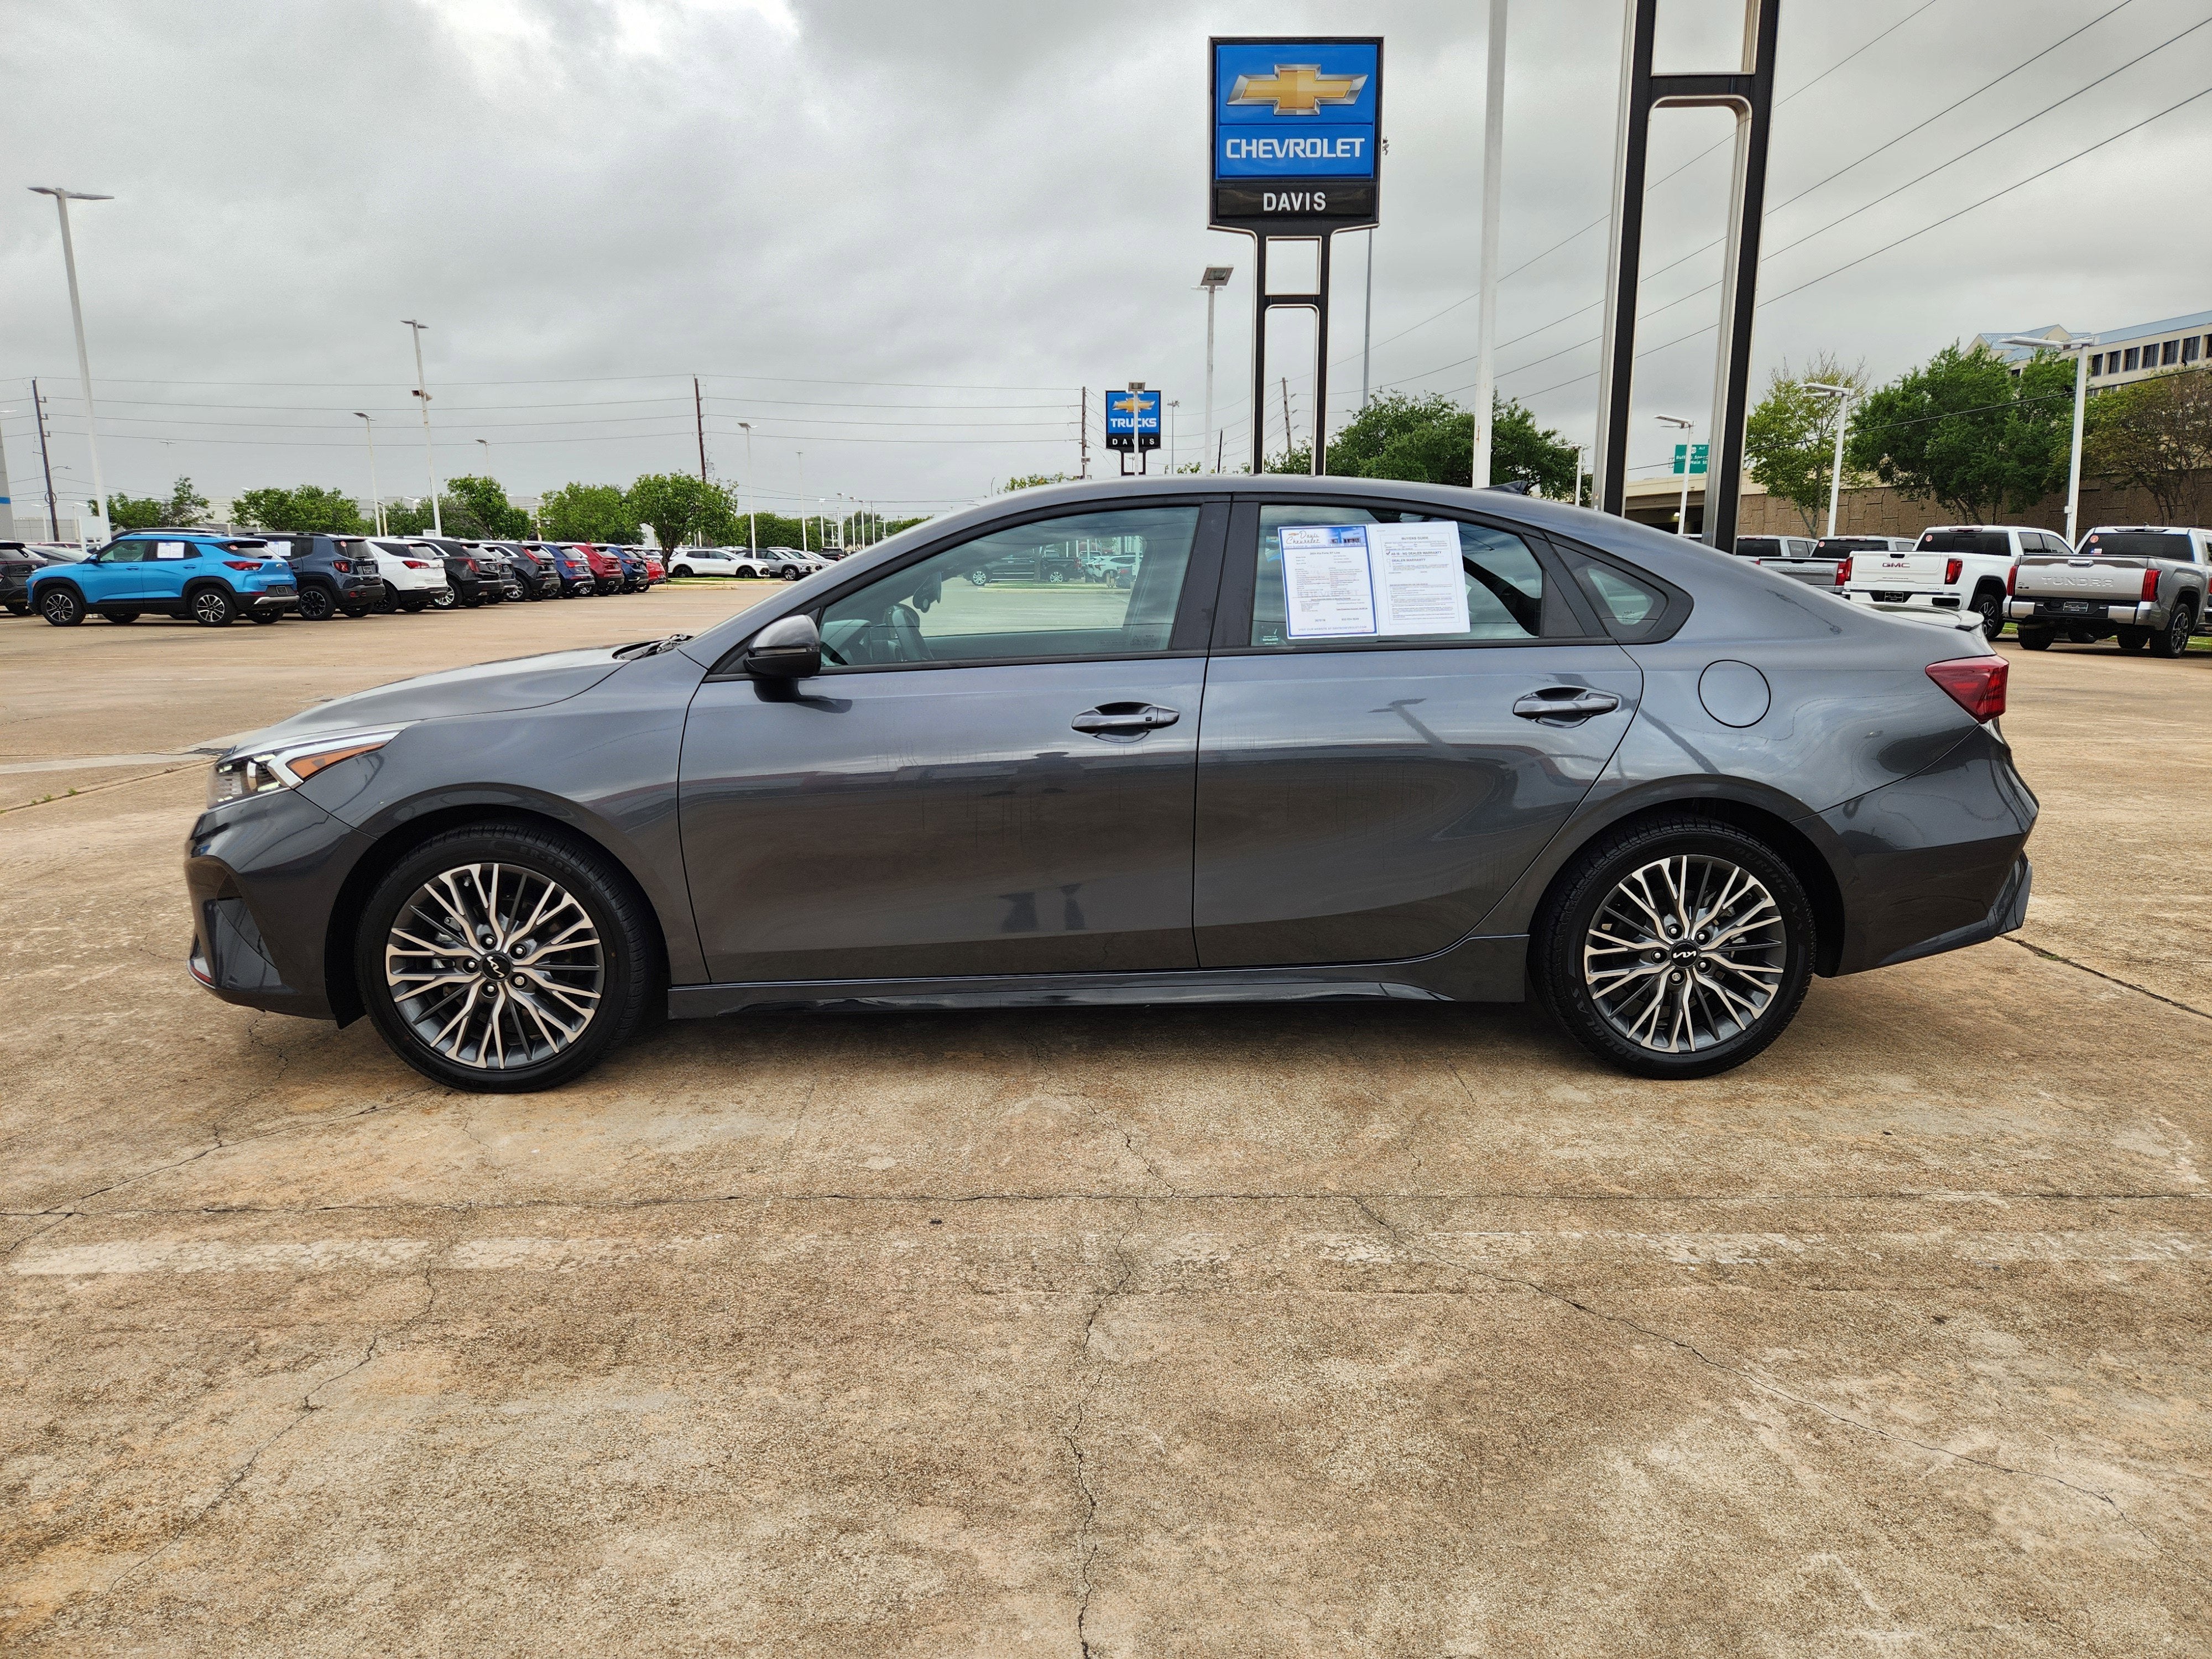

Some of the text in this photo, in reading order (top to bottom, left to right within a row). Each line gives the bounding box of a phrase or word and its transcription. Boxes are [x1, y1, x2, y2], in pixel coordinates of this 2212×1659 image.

[1226, 138, 1365, 158] CHEVROLET
[1263, 192, 1327, 211] DAVIS
[1110, 418, 1157, 428] TRUCKS
[1300, 530, 1319, 539] Davis
[2042, 576, 2114, 587] TUNDRA
[1571, 987, 1642, 1062] DOUGLAS
